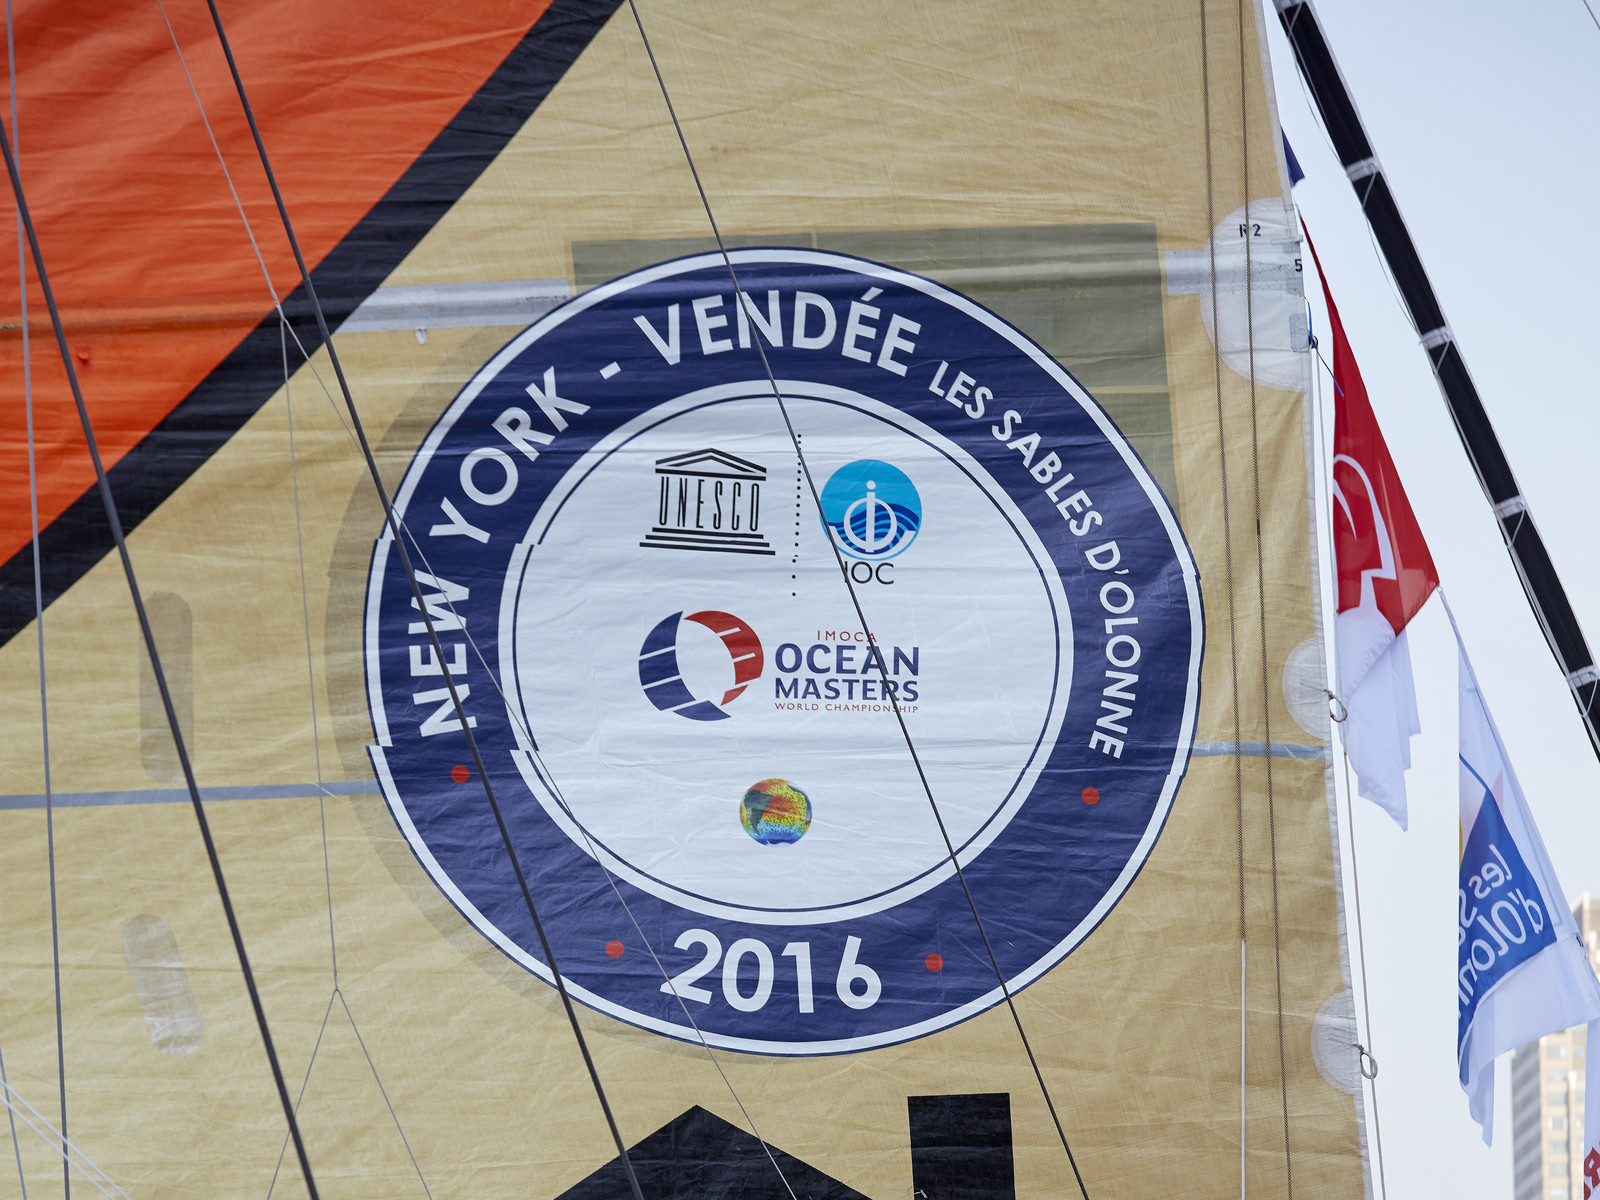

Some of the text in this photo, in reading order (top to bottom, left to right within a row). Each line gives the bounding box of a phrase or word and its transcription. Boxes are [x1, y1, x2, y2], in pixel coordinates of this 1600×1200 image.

[1294, 259, 1302, 272] 5
[633, 287, 921, 377] VENDÉE
[429, 366, 591, 543] YORK
[659, 476, 760, 532] UNESCO
[844, 560, 895, 585] IOC
[928, 361, 1141, 759] LES SABLES D'OLONNE
[408, 569, 477, 736] NEW
[817, 630, 877, 643] IMOCA
[775, 643, 919, 676] OCEAN
[775, 677, 919, 702] MASTERS
[775, 702, 918, 713] WORLD CHAMPIONSHIP
[660, 928, 882, 1013] 2016
